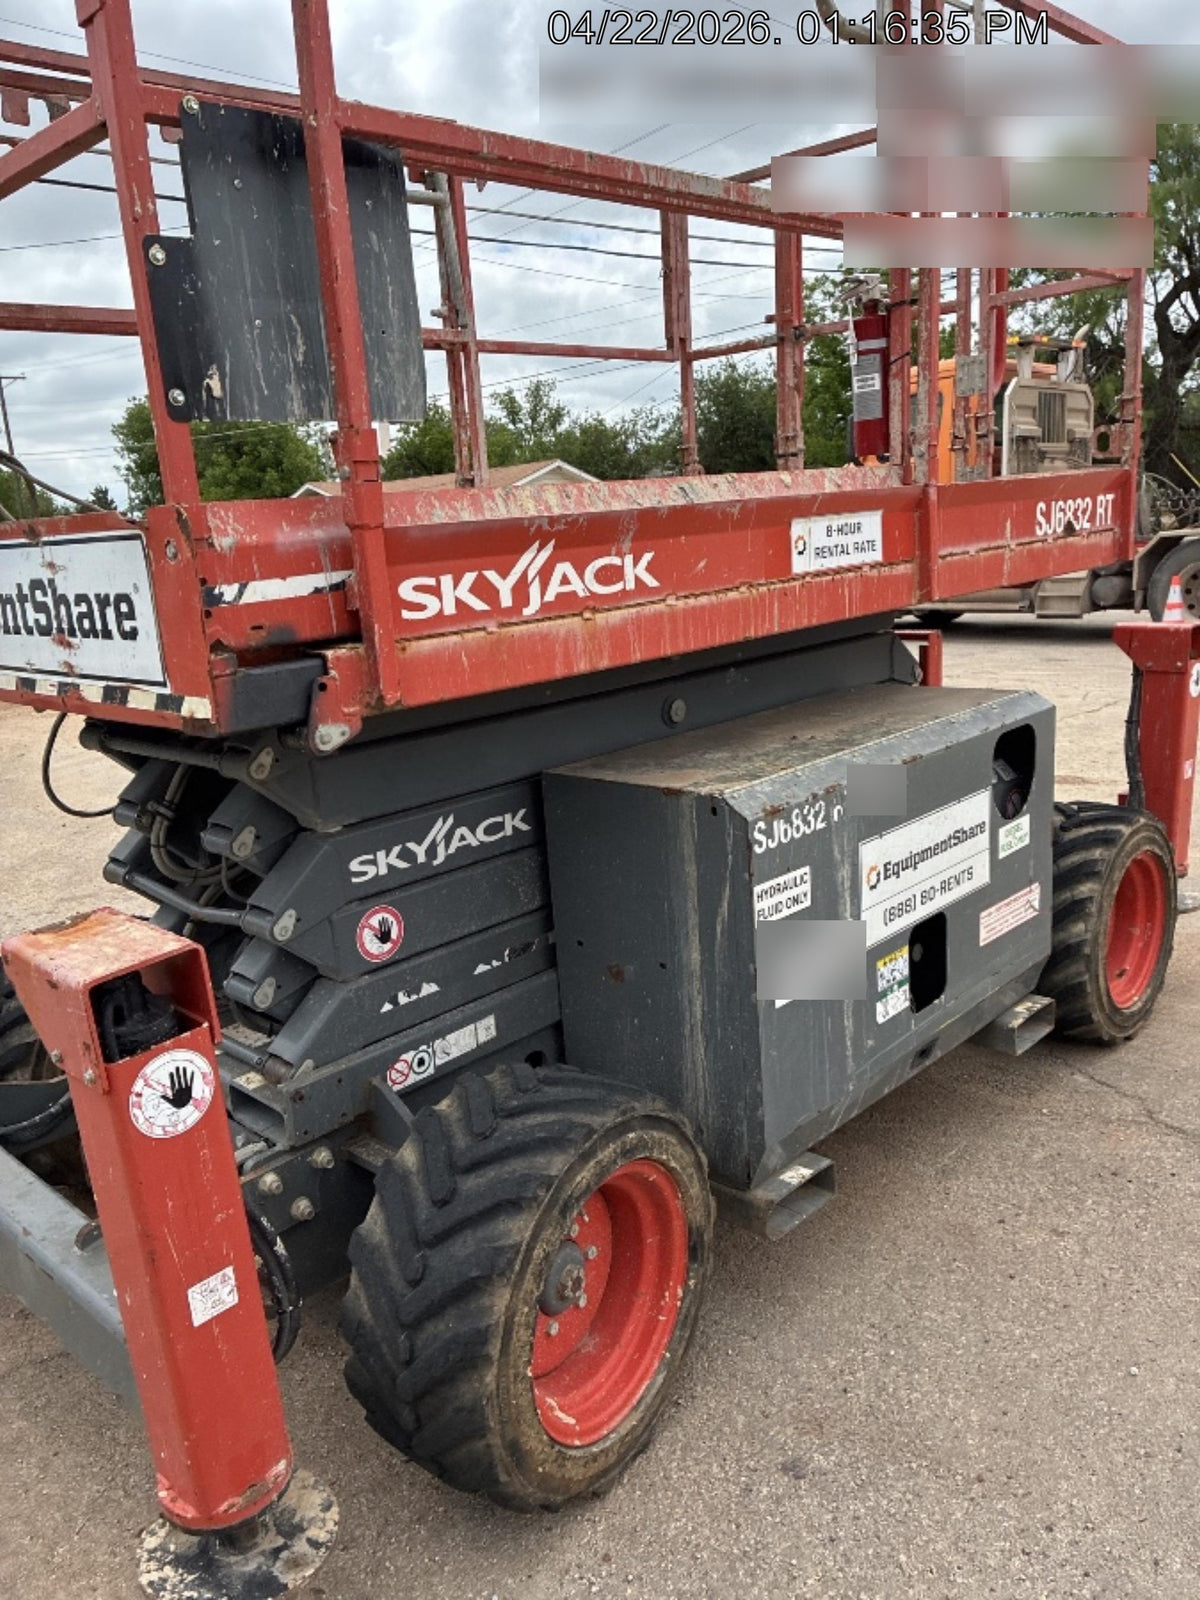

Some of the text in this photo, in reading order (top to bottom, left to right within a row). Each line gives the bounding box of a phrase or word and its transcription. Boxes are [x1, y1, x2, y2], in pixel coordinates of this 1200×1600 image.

[826, 520, 863, 537] 8-HOUR
[1035, 493, 1115, 536] SJ6832 RT
[814, 540, 877, 560] RENTAL RATE
[397, 538, 660, 620] SKYJACK
[348, 808, 531, 883] SKYJACK
[882, 820, 987, 881] EquipmentShare
[756, 871, 809, 903] HYDRAULIC
[757, 888, 809, 920] FLUID ONLY
[883, 866, 974, 926] (888) 80-RENTS
